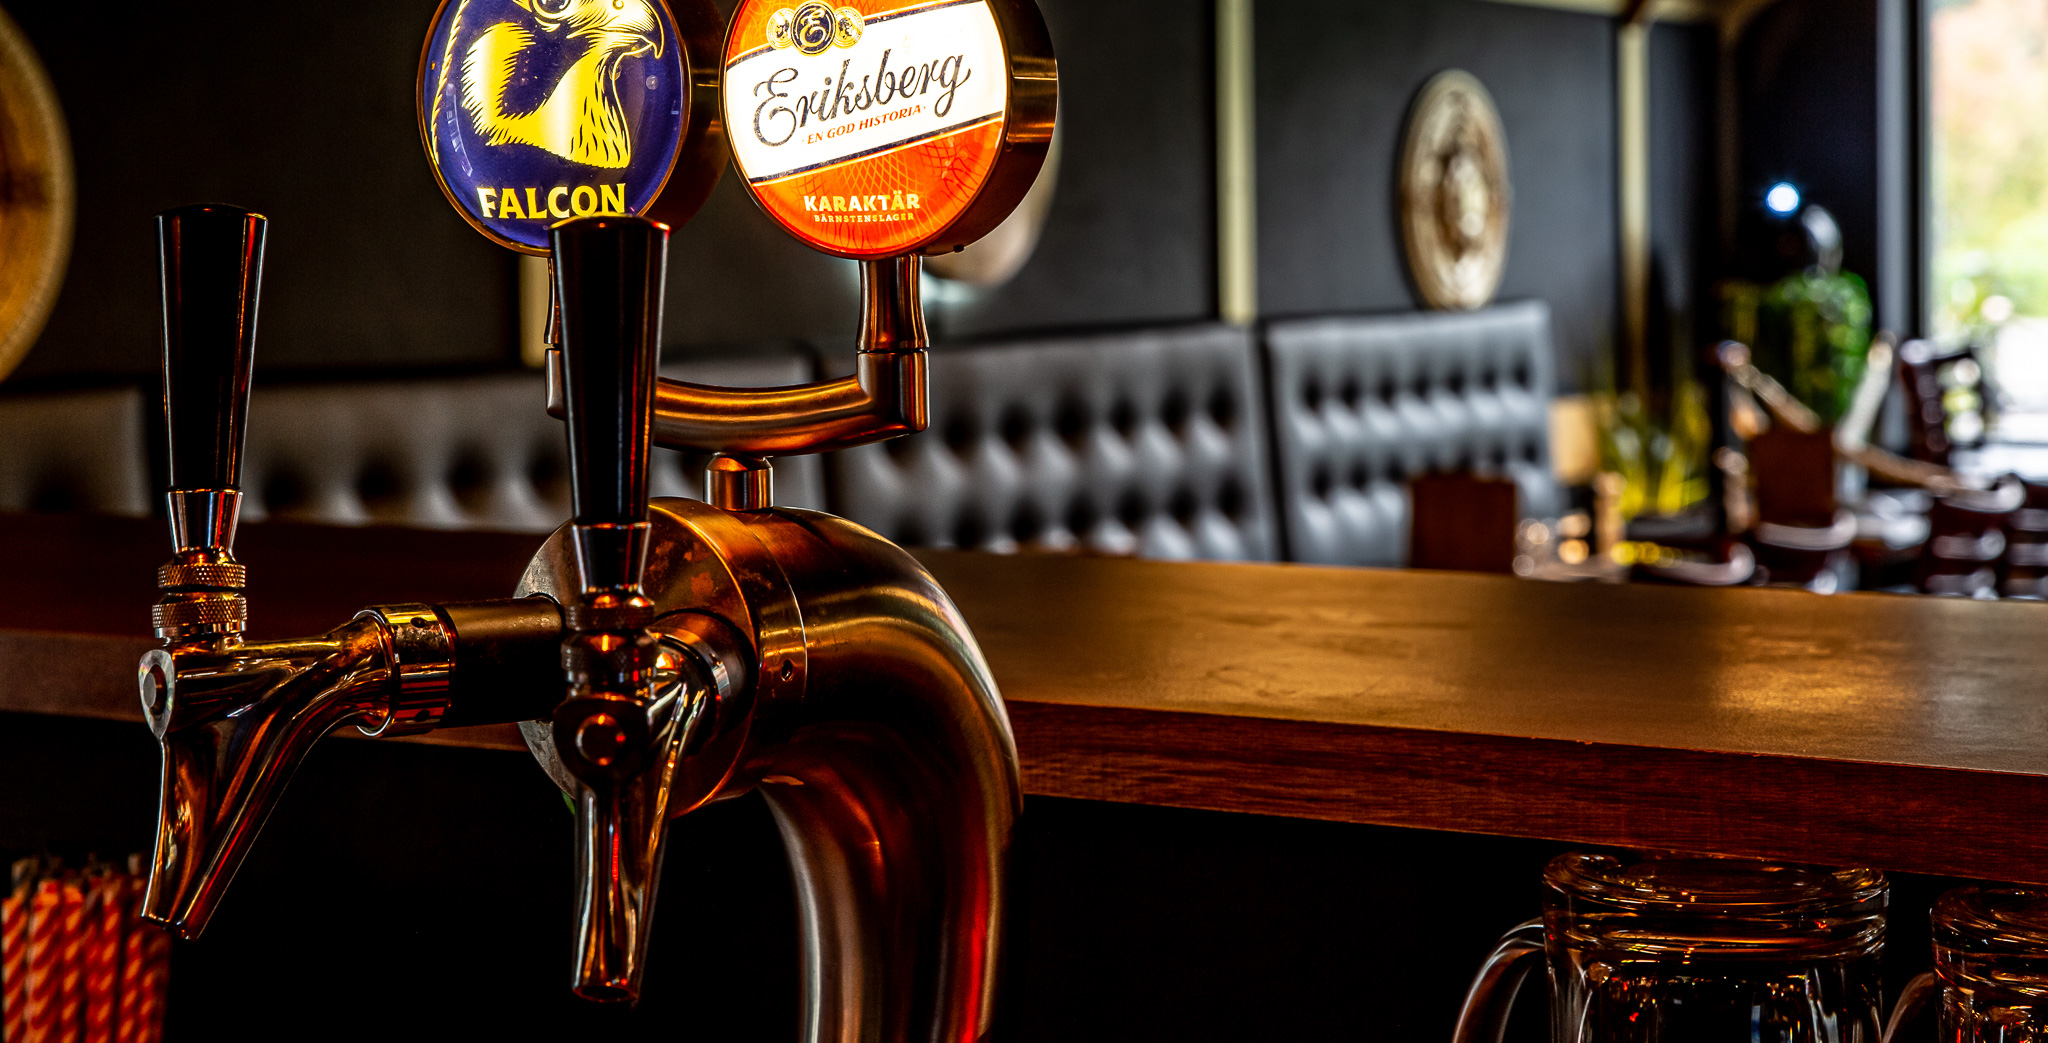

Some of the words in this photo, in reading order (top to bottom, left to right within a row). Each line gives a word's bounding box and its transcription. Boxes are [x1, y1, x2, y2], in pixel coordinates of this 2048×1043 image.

[753, 48, 971, 147] Eriksberg
[807, 131, 823, 145] EN
[827, 123, 855, 139] GOD
[858, 104, 921, 131] HISTORIA
[476, 183, 626, 219] FALCON
[803, 190, 920, 211] KARAKTÄR
[814, 213, 914, 223] BÄRNSTENSLAGER
